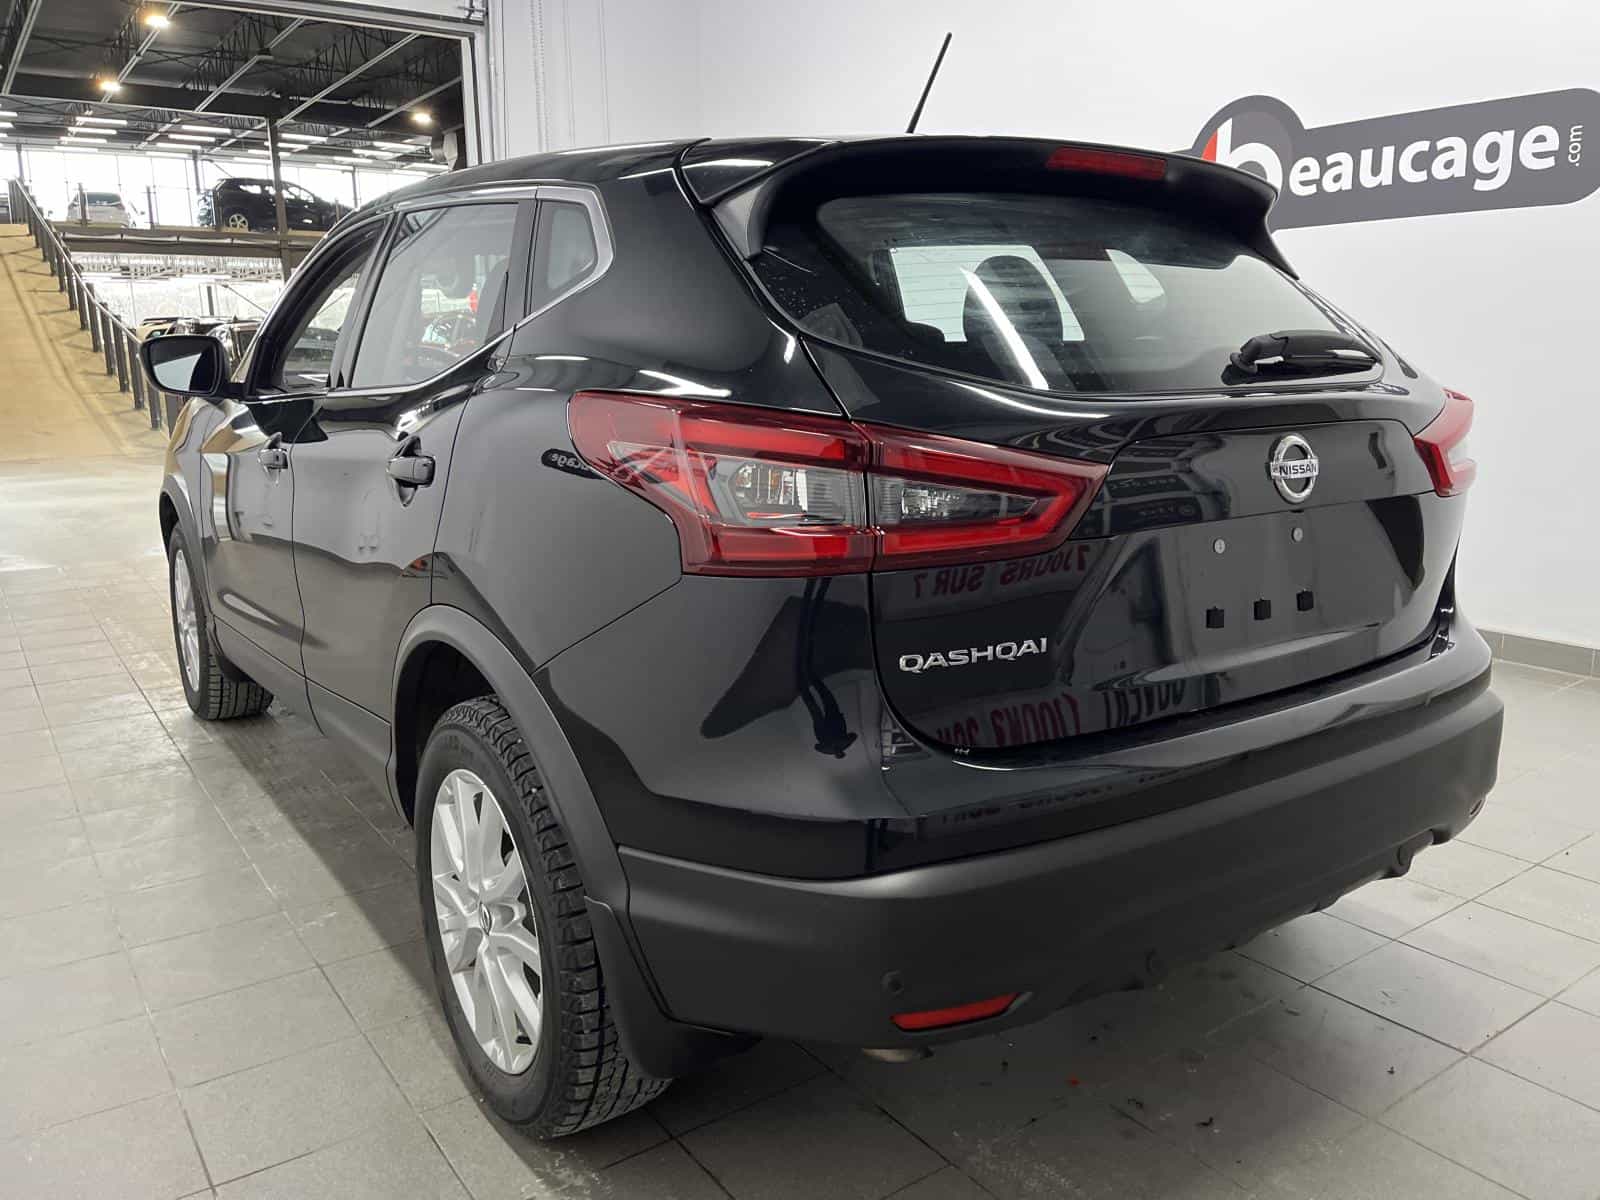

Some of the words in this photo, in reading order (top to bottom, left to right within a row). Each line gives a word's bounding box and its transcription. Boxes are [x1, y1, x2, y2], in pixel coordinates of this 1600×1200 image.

[1568, 125, 1584, 167] .com
[1280, 463, 1317, 476] NISSAN
[899, 637, 1048, 673] QASHQAI
